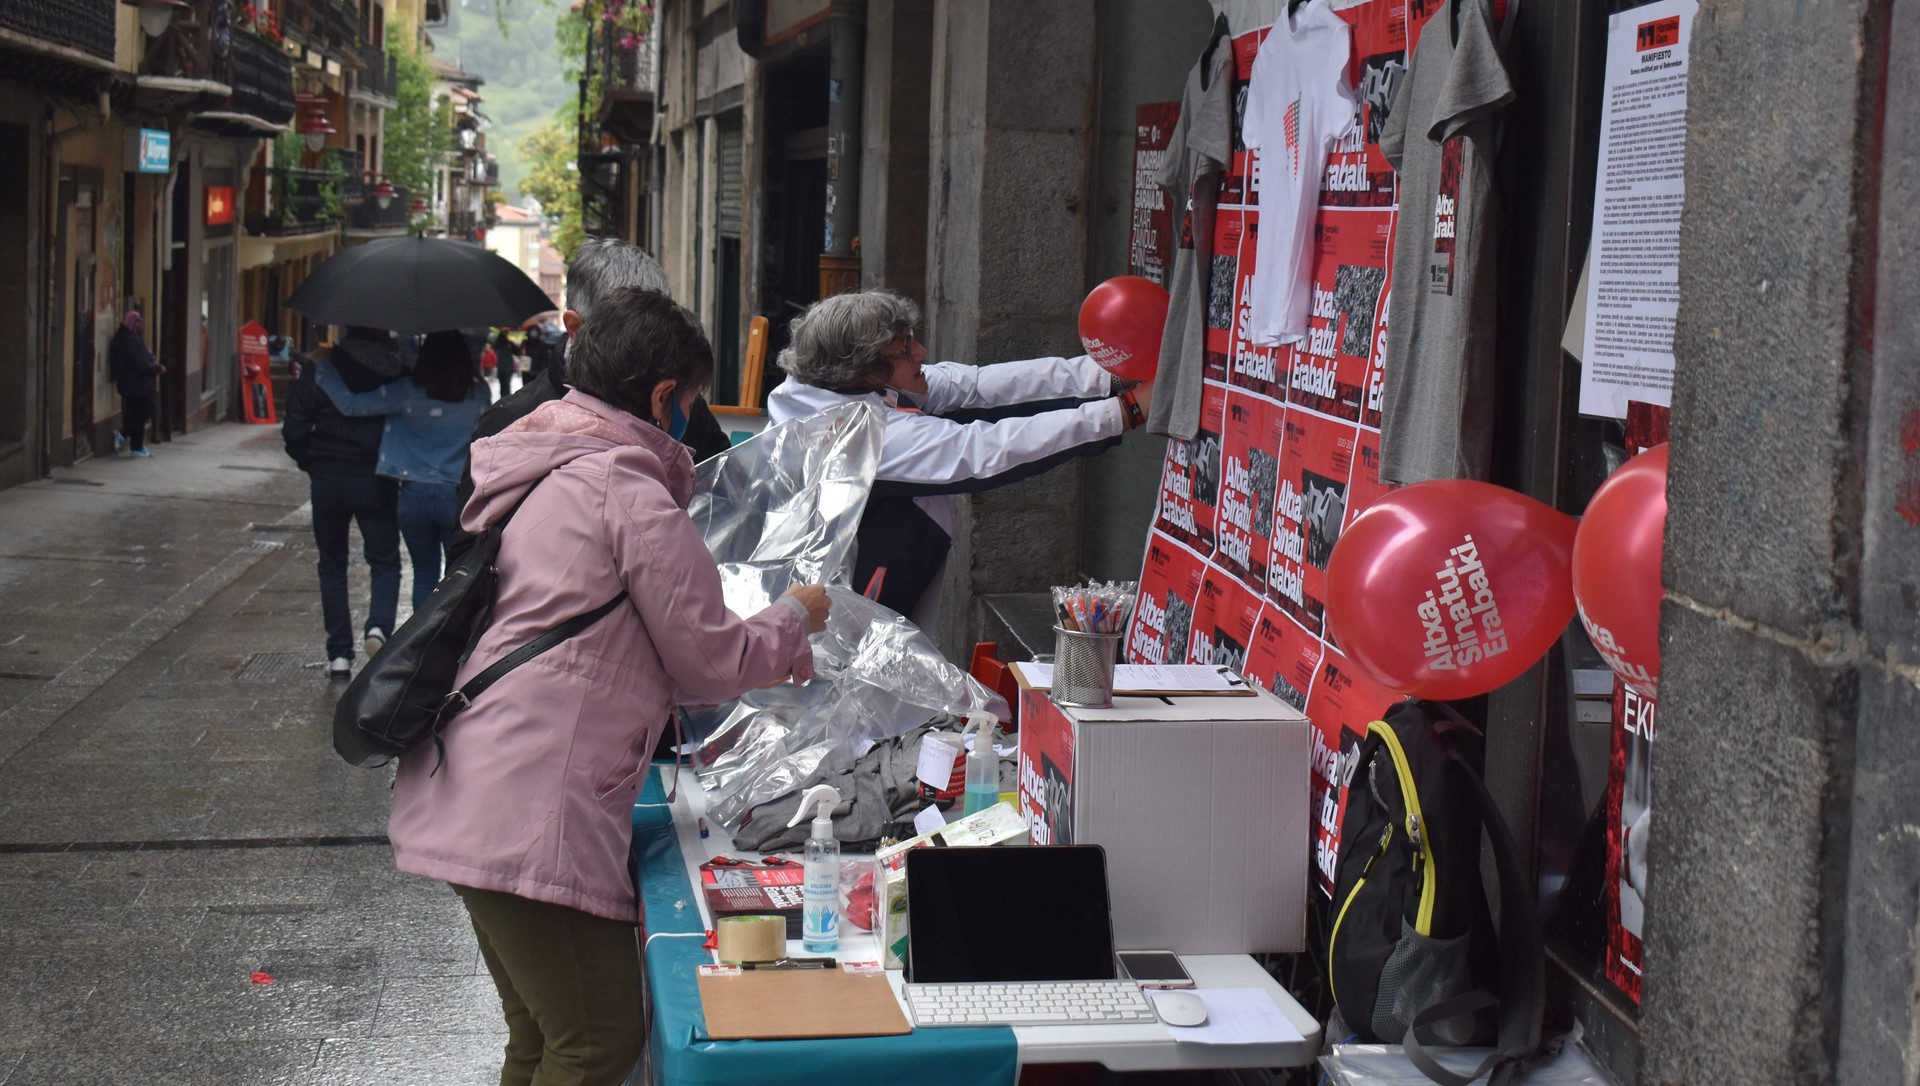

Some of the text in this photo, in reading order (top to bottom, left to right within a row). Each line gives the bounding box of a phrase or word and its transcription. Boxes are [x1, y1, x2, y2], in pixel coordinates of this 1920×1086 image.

[1641, 49, 1672, 64] MANIFIESTO
[1324, 153, 1371, 192] rabaki.
[1291, 353, 1339, 400] Erabaki.
[1161, 489, 1199, 537] Erabaki.
[1436, 557, 1483, 668] Sinatu.
[1449, 534, 1509, 660] Erabaki.
[1417, 590, 1457, 671] Altxa.
[1623, 690, 1658, 743] EKI
